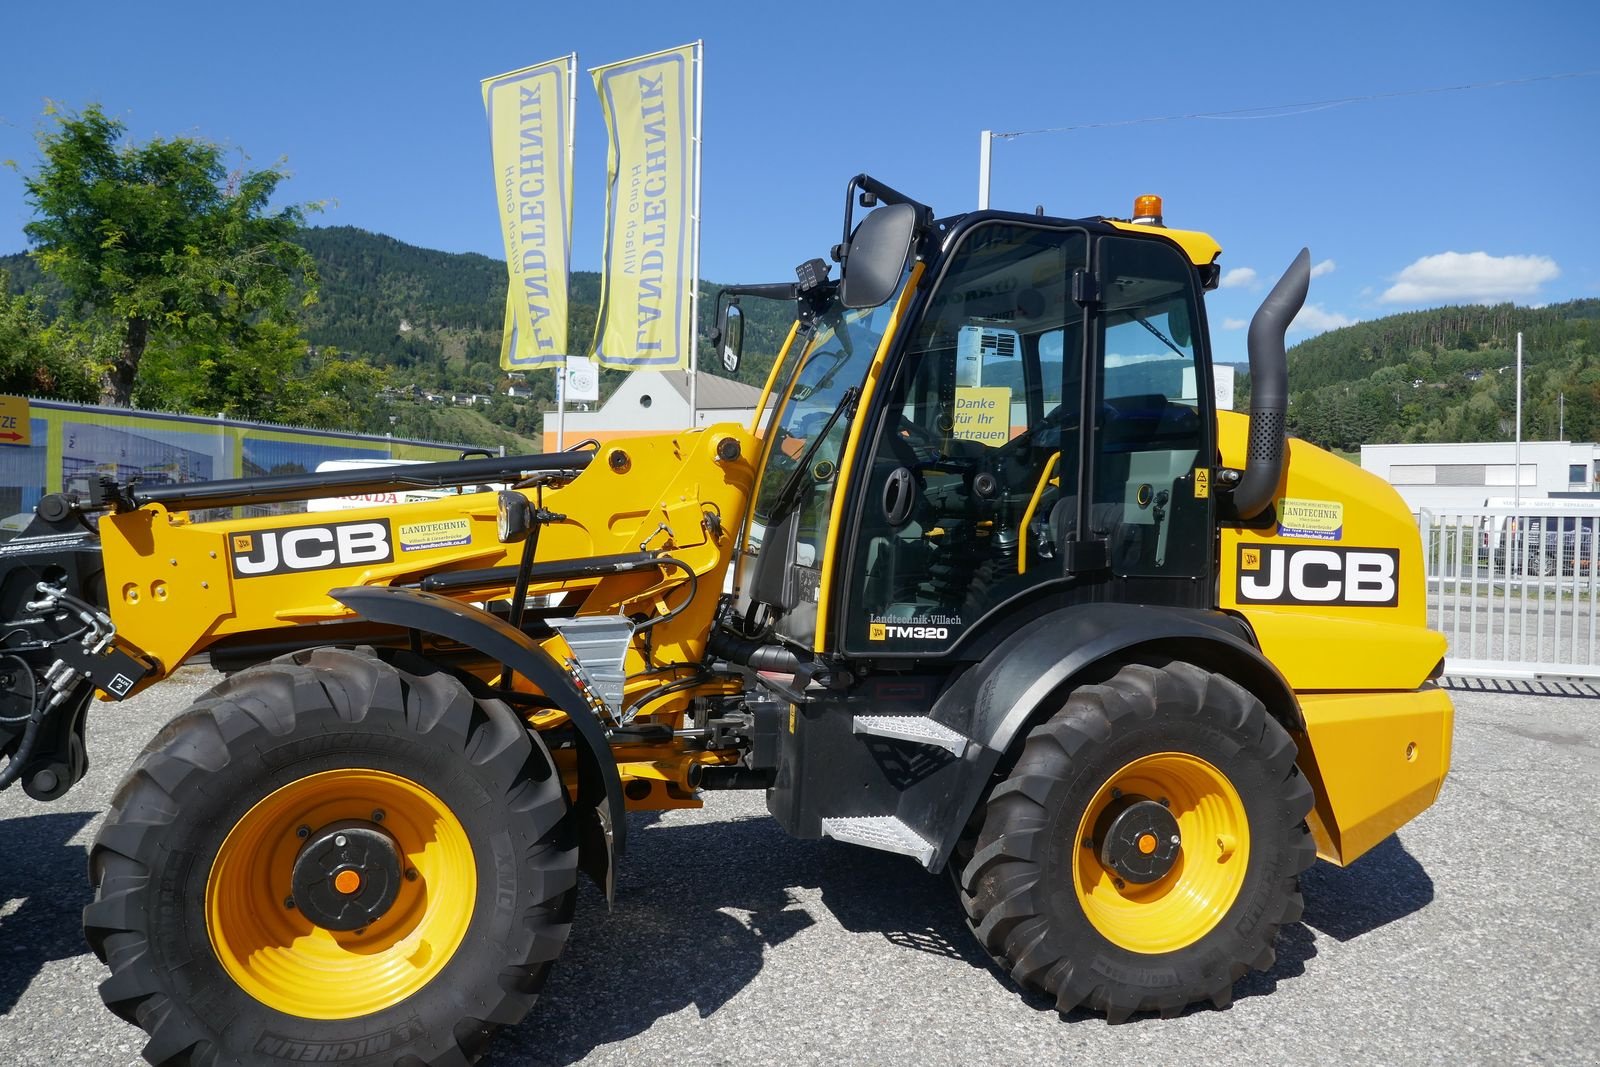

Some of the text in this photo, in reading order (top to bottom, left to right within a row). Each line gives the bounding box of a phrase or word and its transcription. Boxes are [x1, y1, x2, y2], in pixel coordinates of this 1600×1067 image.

[956, 397, 996, 409] Danke
[0, 415, 17, 429] ZE
[955, 412, 994, 424] für Ihr
[953, 430, 1005, 440] ertrauen
[1282, 506, 1338, 519] LANDTECHNIK
[401, 521, 467, 534] LANDTECHNIK
[235, 522, 390, 574] JCB
[1240, 549, 1396, 602] JCB
[886, 626, 948, 639] TM320
[116, 677, 130, 687] AUX
[256, 1032, 394, 1063] MICHELIN
